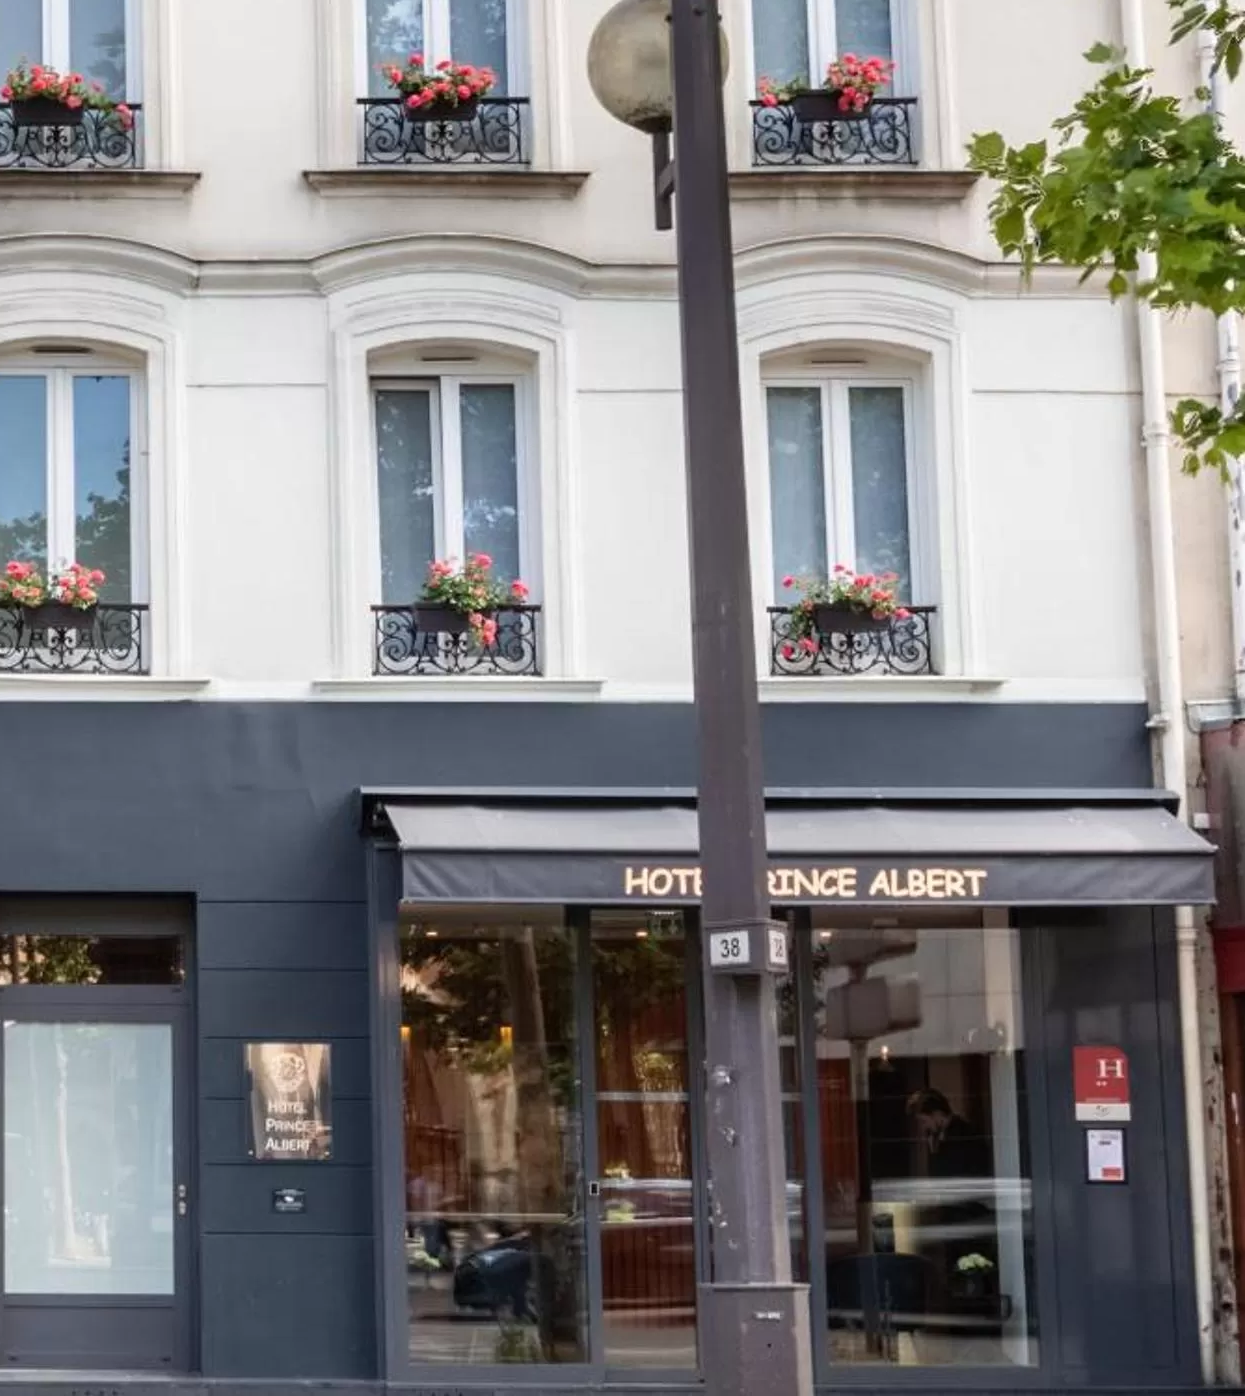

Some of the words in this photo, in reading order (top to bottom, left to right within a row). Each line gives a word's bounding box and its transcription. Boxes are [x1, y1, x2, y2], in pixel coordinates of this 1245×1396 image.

[625, 867, 703, 897] HOTE
[767, 867, 857, 898] RINCE
[869, 868, 989, 898] ALBERT
[720, 937, 741, 958] 38
[1096, 1058, 1125, 1079] H
